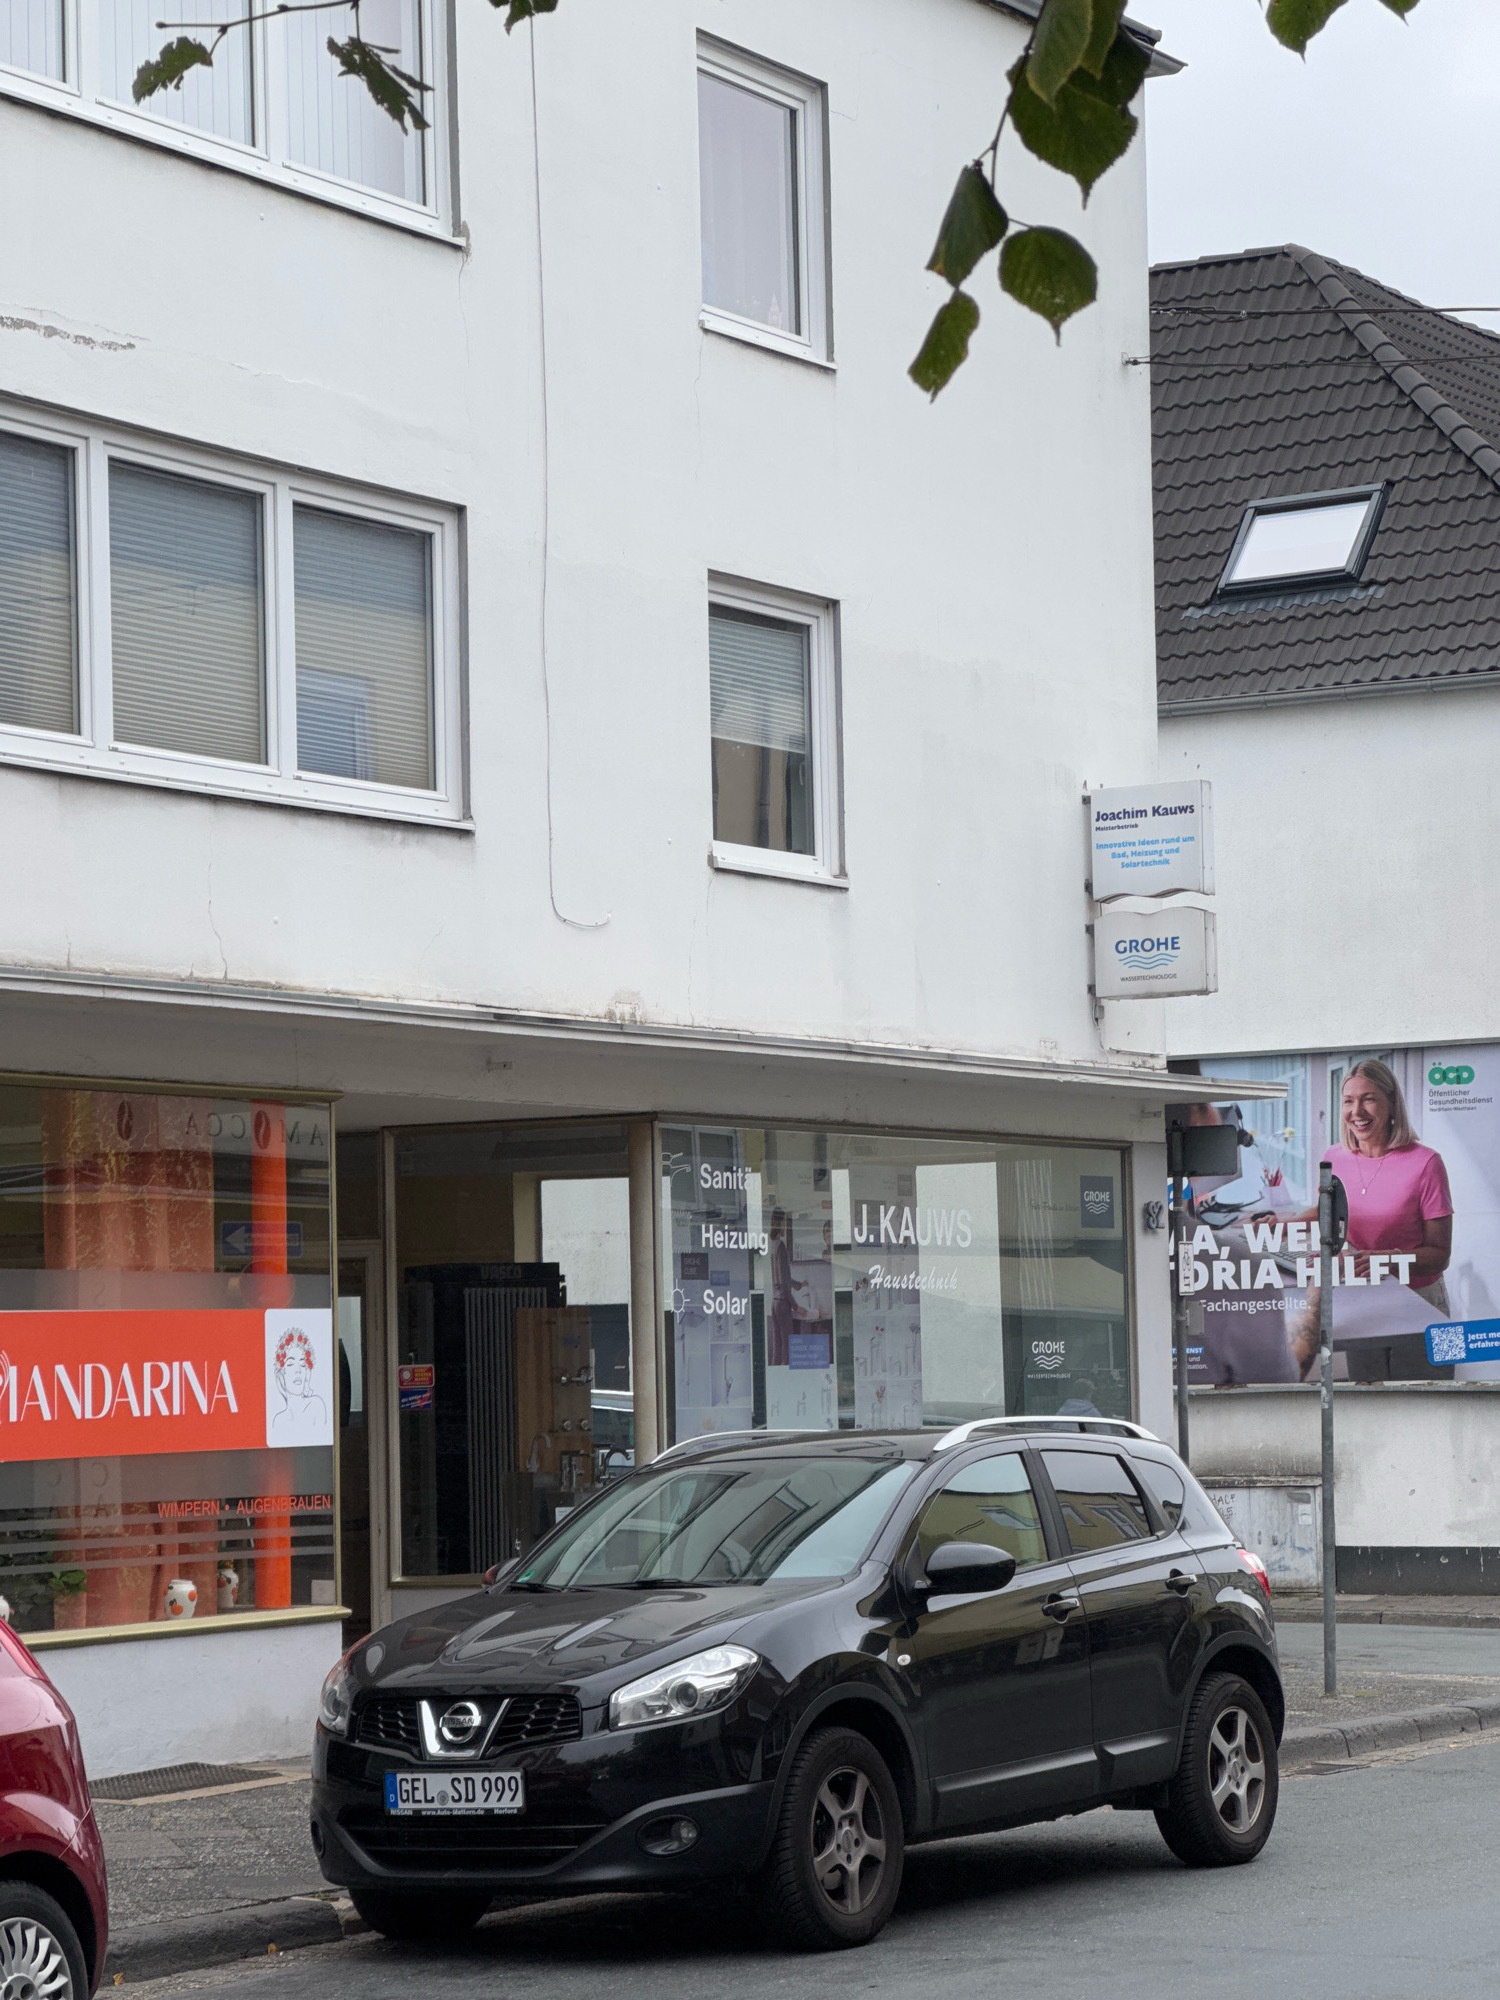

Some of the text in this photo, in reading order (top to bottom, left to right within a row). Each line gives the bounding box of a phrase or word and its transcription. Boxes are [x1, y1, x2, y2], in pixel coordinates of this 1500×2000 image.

[1095, 804, 1195, 823] Joachim Kauws
[1095, 823, 1139, 832] Meisterbetrieb
[1096, 840, 1137, 850] Innovative
[1138, 838, 1160, 846] Ideen
[1161, 836, 1180, 844] rund
[1111, 851, 1129, 859] Bad,
[1131, 848, 1163, 857] Heizung
[1120, 858, 1170, 869] Solartechnik
[1114, 936, 1181, 954] GROHE
[1120, 973, 1178, 982] WASSERTECHNOLOGIE
[1429, 1089, 1470, 1098] Öffentlicher
[1429, 1096, 1493, 1106] Gesundheitsdienst
[1083, 1190, 1110, 1202] GROHE
[701, 1223, 769, 1256] Heizung
[868, 1264, 958, 1290] Haustechnik
[1296, 1254, 1417, 1288] HILFT
[702, 1289, 748, 1315] Solar
[1031, 1341, 1066, 1354] GROHE
[1469, 1340, 1500, 1349] erfahre
[157, 1495, 331, 1518] WIMPERN AUGENBRAUEN
[399, 1775, 519, 1804] GEL SD 999
[493, 1807, 518, 1815] Herford
